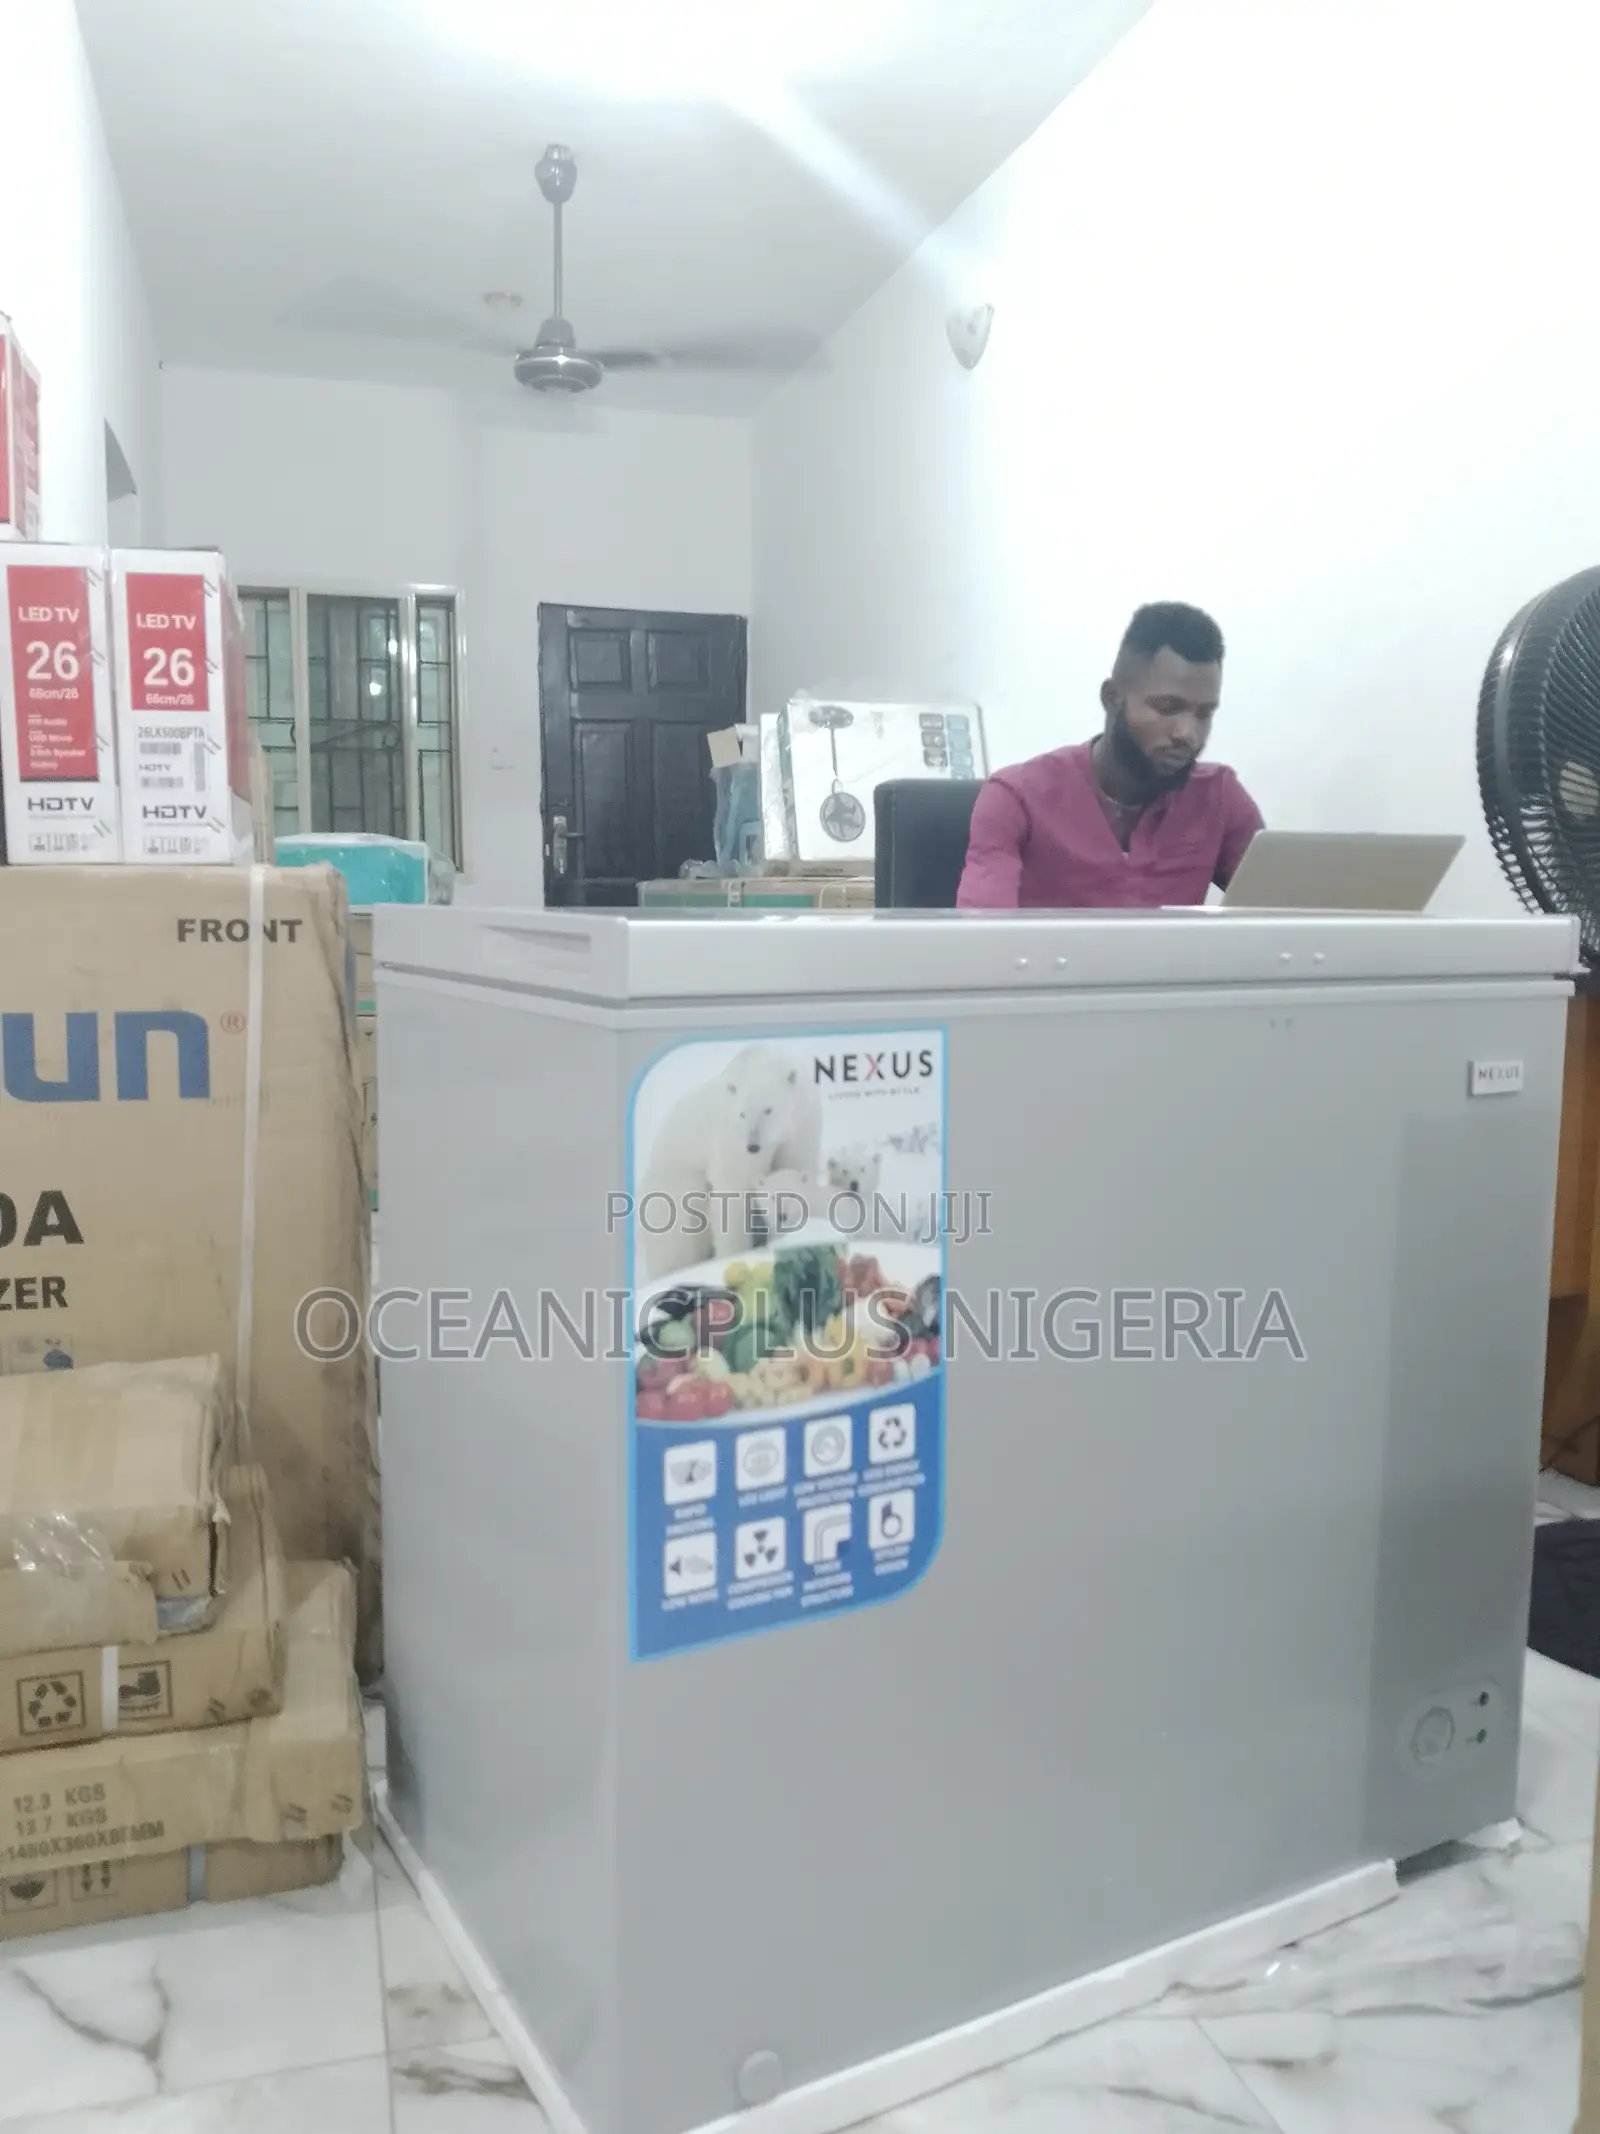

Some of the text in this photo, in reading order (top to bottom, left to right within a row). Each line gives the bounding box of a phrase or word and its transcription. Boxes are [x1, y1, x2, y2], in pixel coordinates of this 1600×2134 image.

[18, 605, 80, 624] LED TV
[136, 613, 197, 630] LED TV
[26, 640, 79, 681] 26
[143, 647, 195, 687] 26
[28, 797, 94, 812] HDTV
[142, 804, 208, 820] HDTV
[177, 918, 303, 943] FRONT
[813, 1049, 934, 1085] NEXUS
